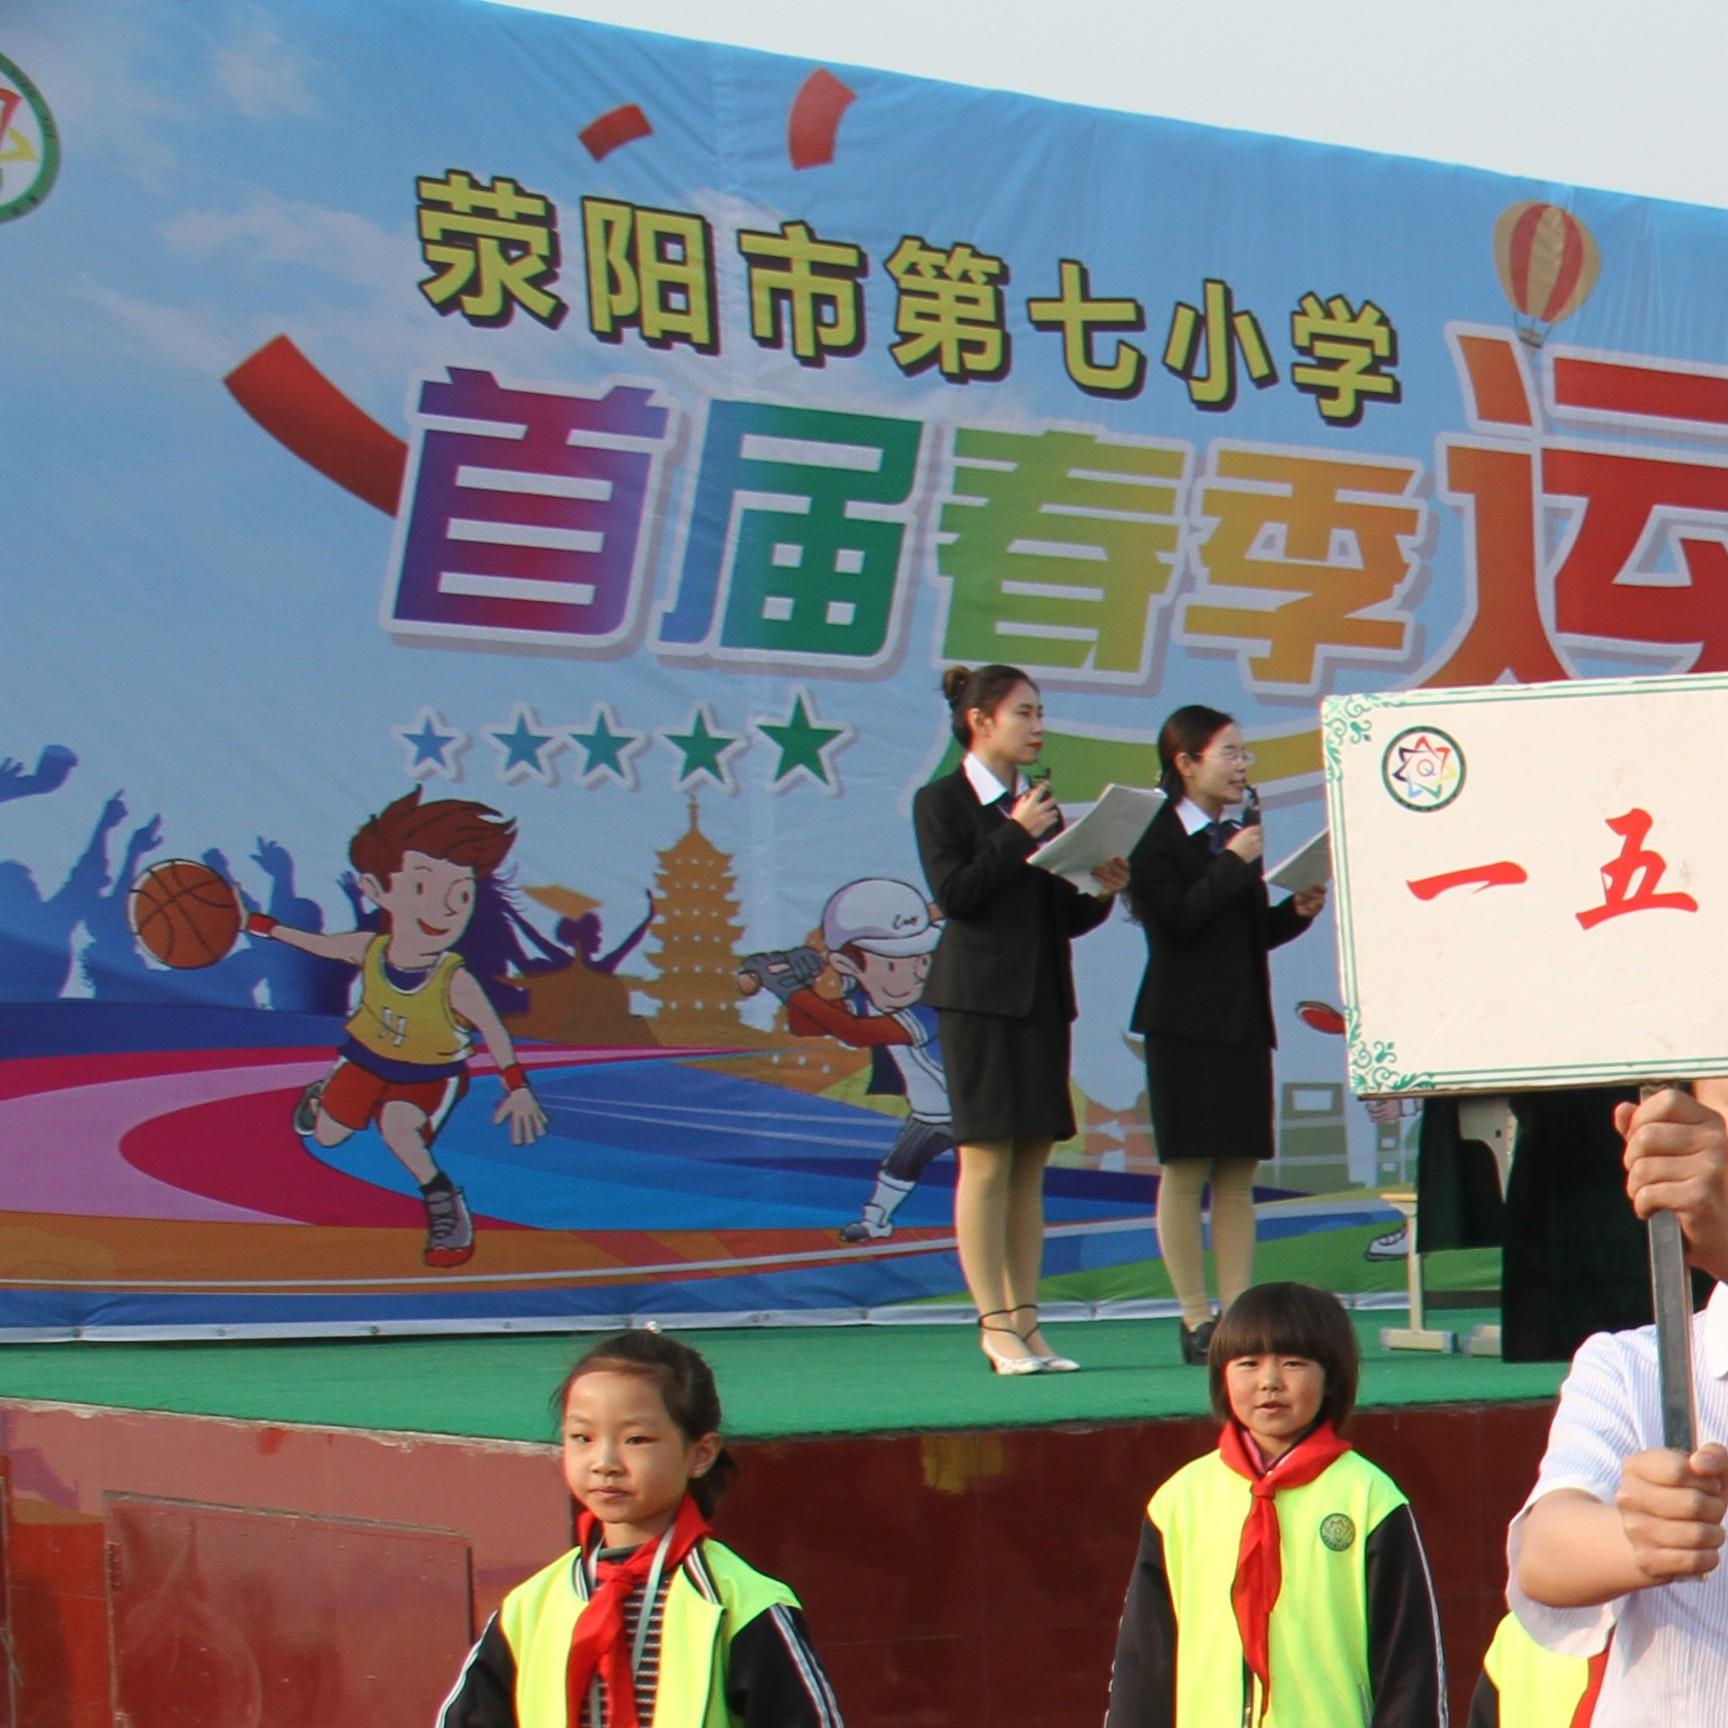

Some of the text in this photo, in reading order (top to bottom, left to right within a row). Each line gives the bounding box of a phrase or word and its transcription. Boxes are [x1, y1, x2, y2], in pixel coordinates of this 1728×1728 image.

[414, 166, 1402, 427] 荥阳市第七小学
